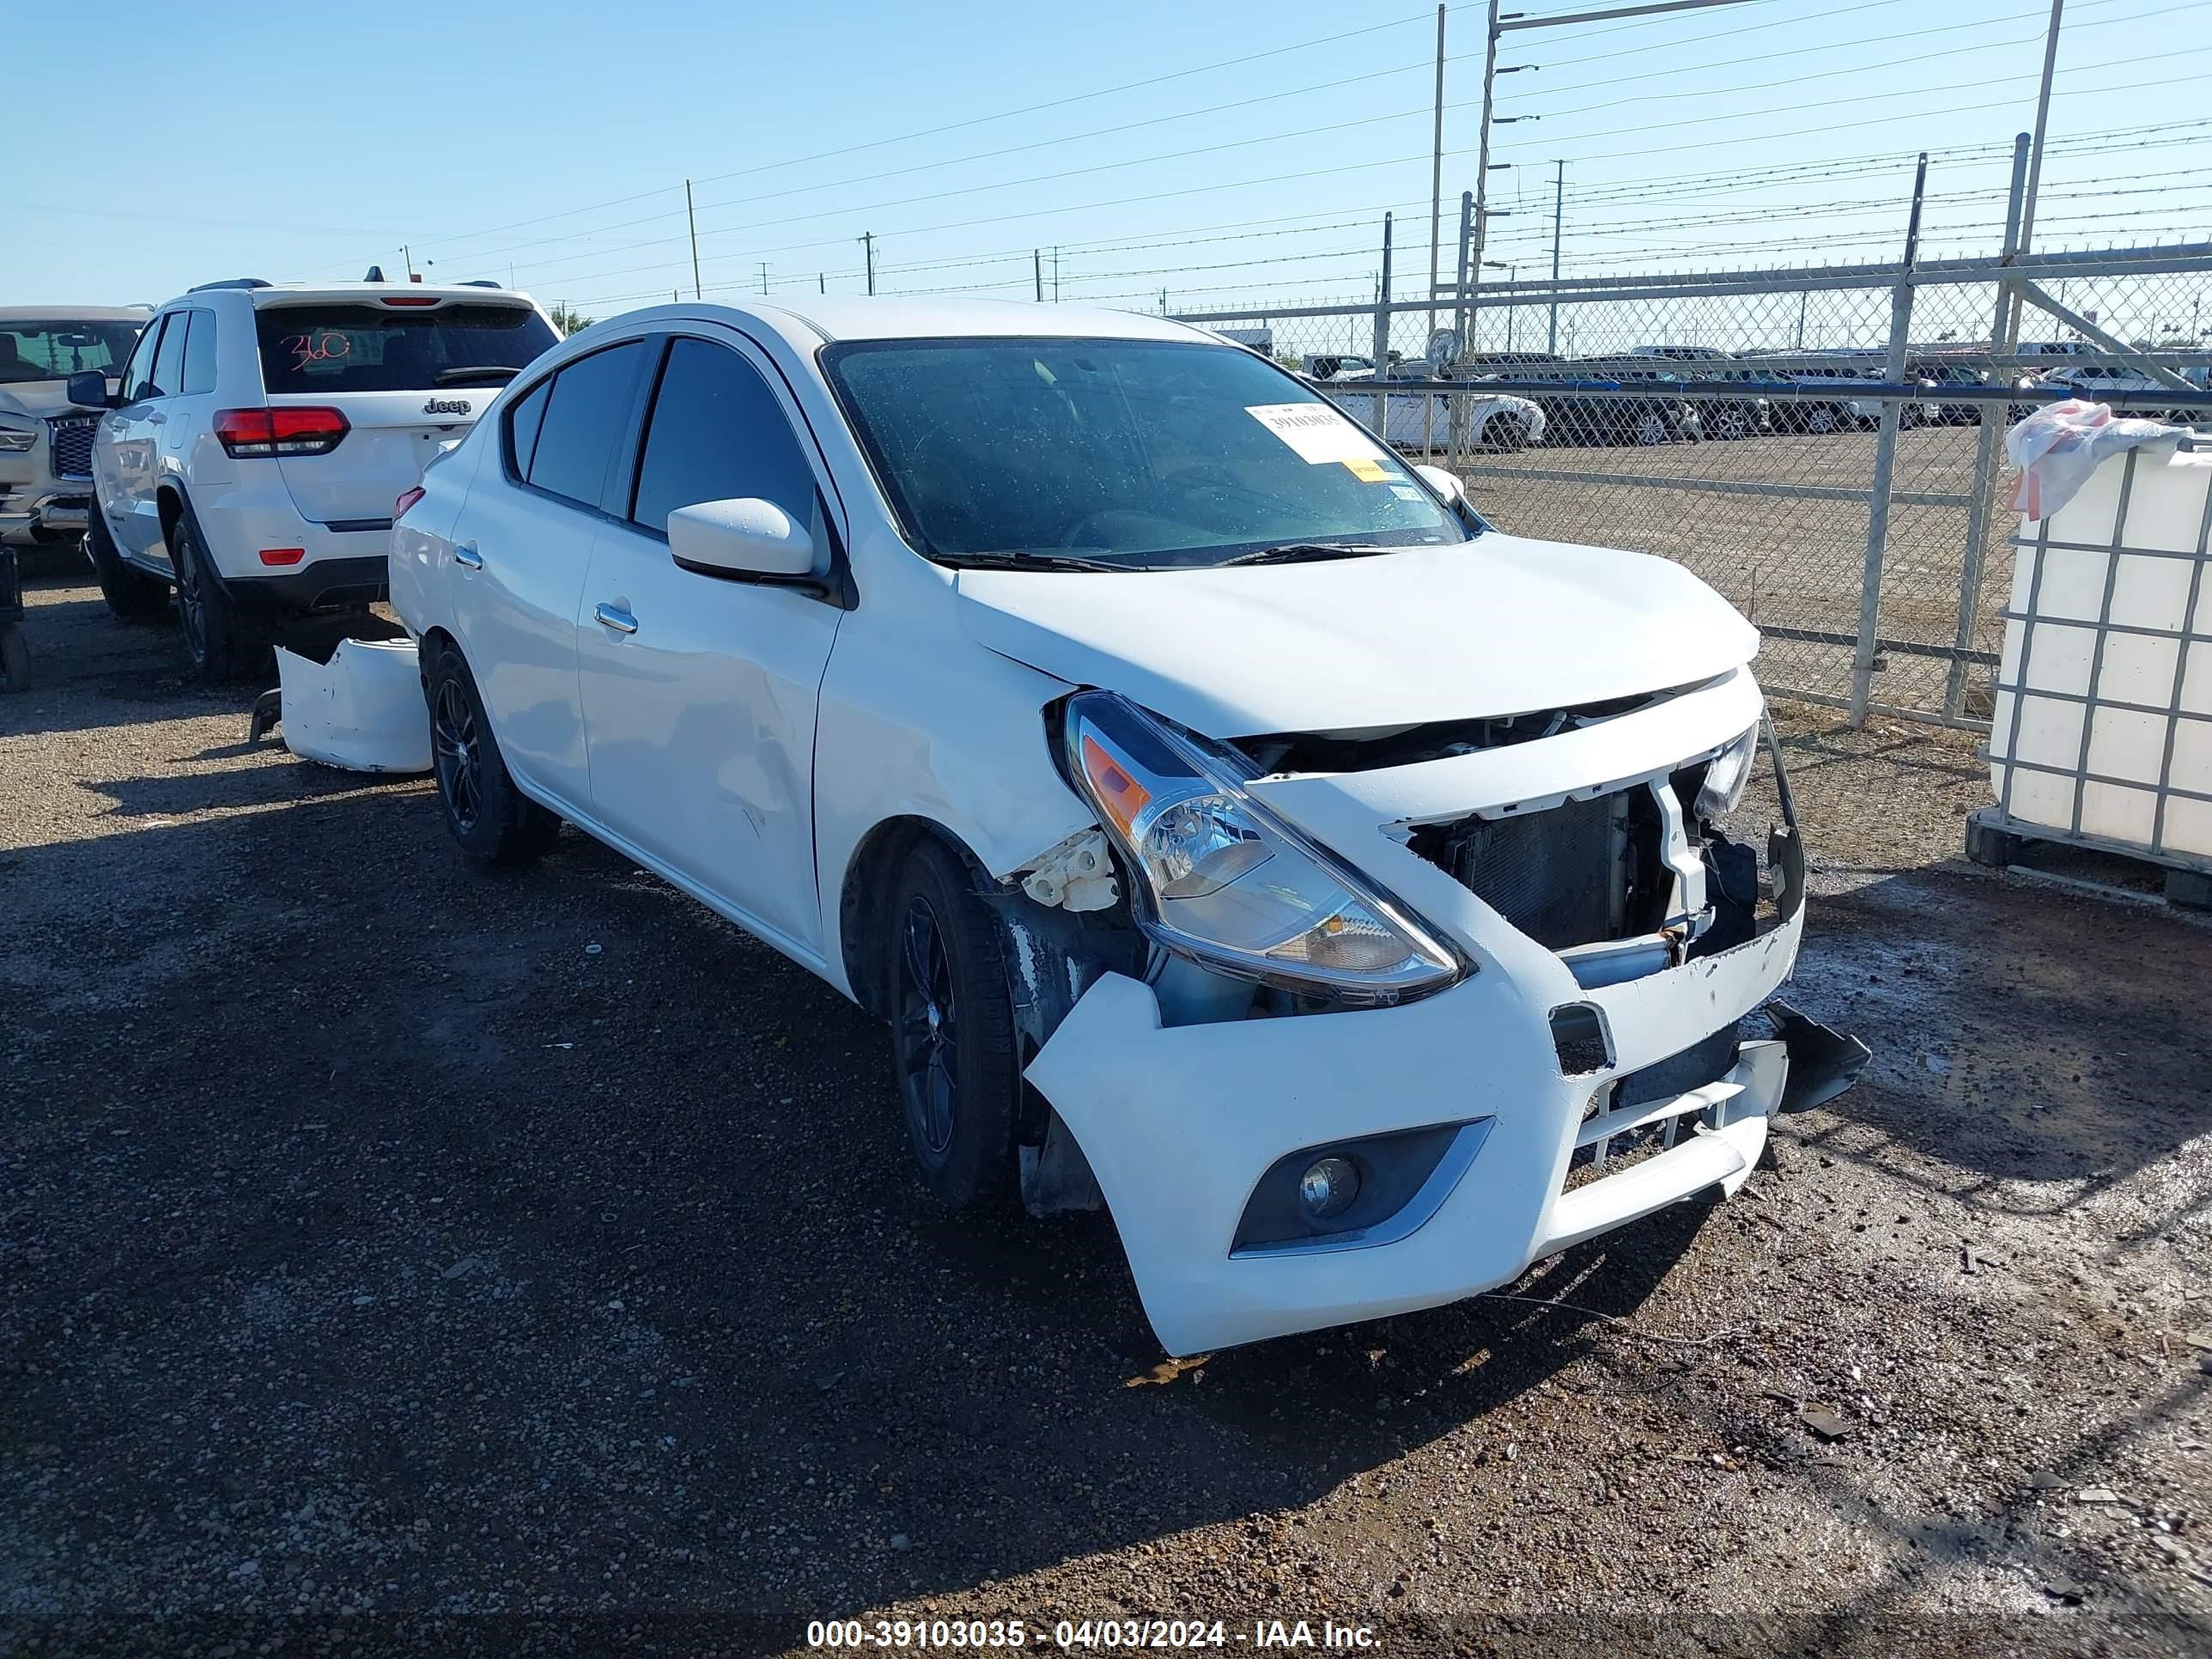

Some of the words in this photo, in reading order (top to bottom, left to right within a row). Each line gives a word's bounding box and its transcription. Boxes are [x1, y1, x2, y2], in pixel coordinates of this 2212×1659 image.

[281, 332, 350, 371] 360
[424, 398, 471, 416] Jeep
[1269, 414, 1341, 430] 39103035
